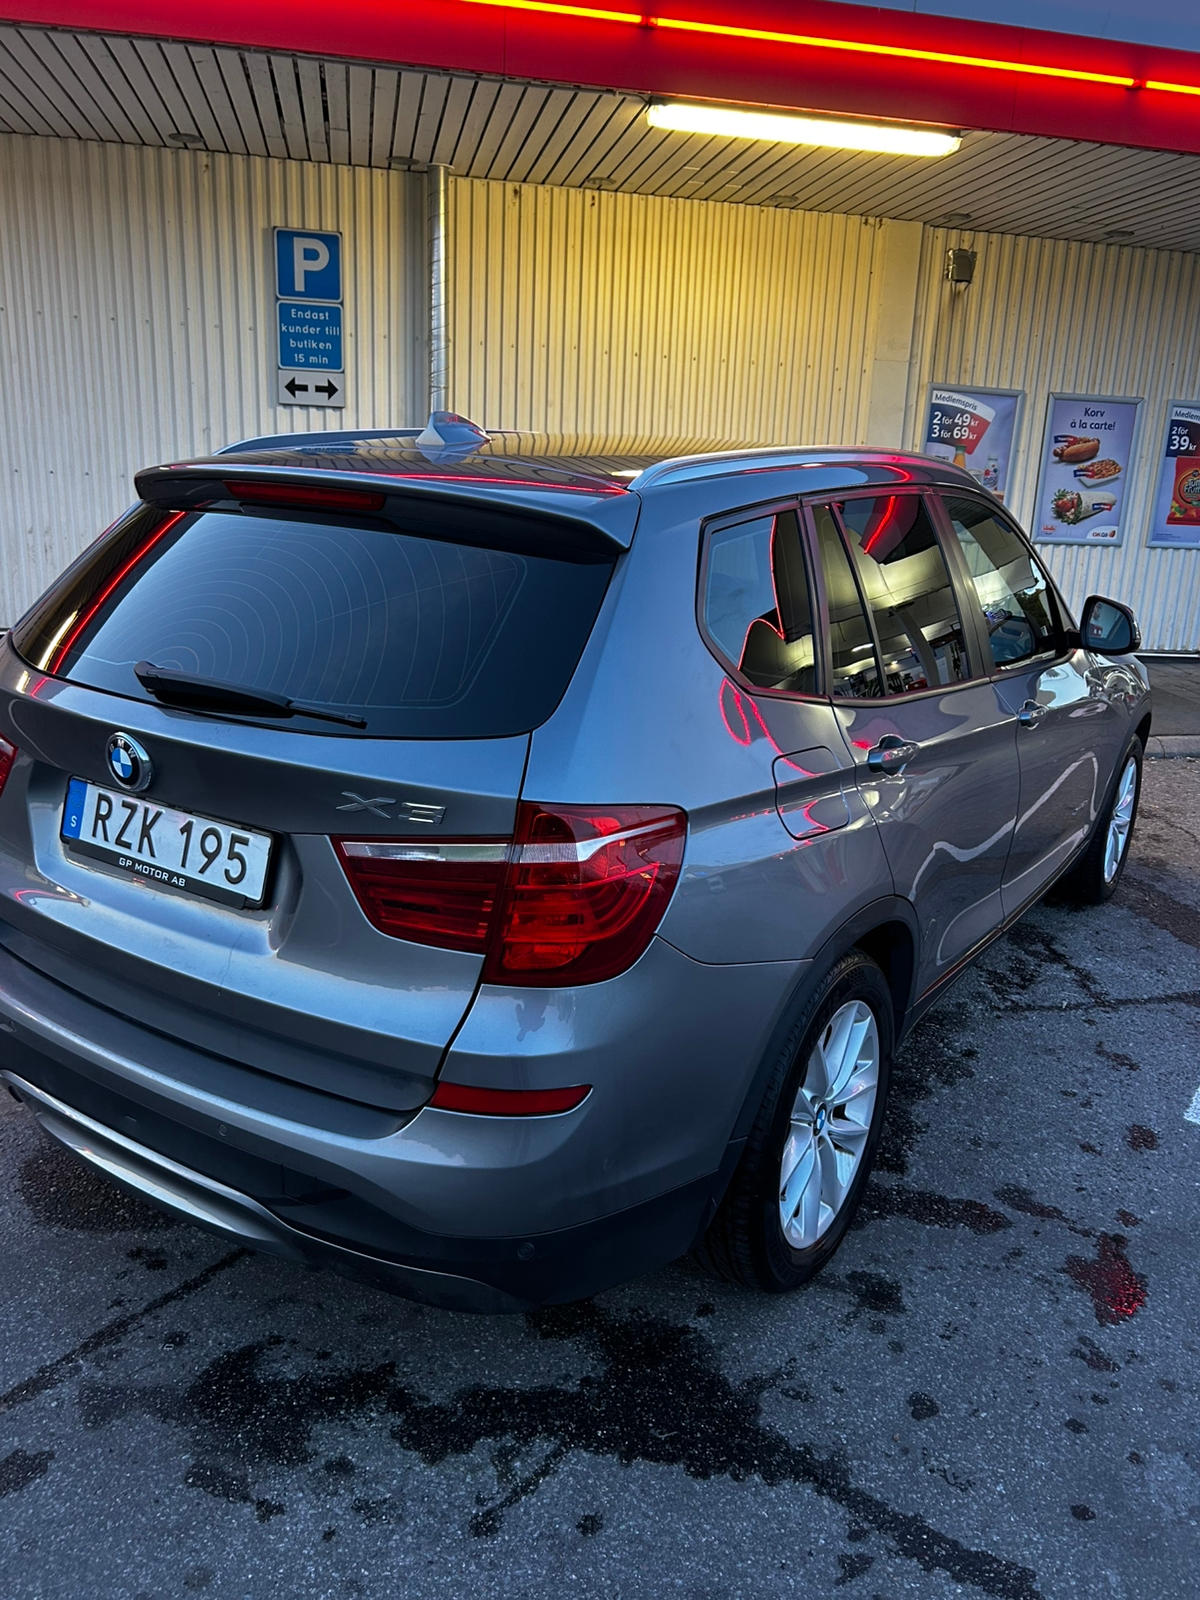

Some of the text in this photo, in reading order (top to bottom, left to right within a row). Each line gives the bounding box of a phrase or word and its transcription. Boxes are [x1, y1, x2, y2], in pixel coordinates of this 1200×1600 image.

[293, 236, 330, 292] P
[291, 308, 329, 320] Endast
[281, 323, 340, 336] kunder till
[290, 338, 332, 350] butiken
[294, 353, 329, 364] 15 min
[935, 394, 977, 410] Medlemspris
[933, 411, 980, 427] 2 för 49 kr
[1084, 406, 1106, 418] Korv
[931, 425, 978, 440] 3 för 69 kr
[1079, 419, 1088, 430] la
[1089, 421, 1116, 431] carte!
[1171, 426, 1189, 435] 2 för
[1169, 435, 1197, 451] 39 kr
[109, 738, 137, 758] BMW
[335, 790, 447, 825] X3
[70, 815, 78, 828] S
[91, 792, 250, 885] RZK 195
[118, 856, 186, 887] GP MOTOR AB
